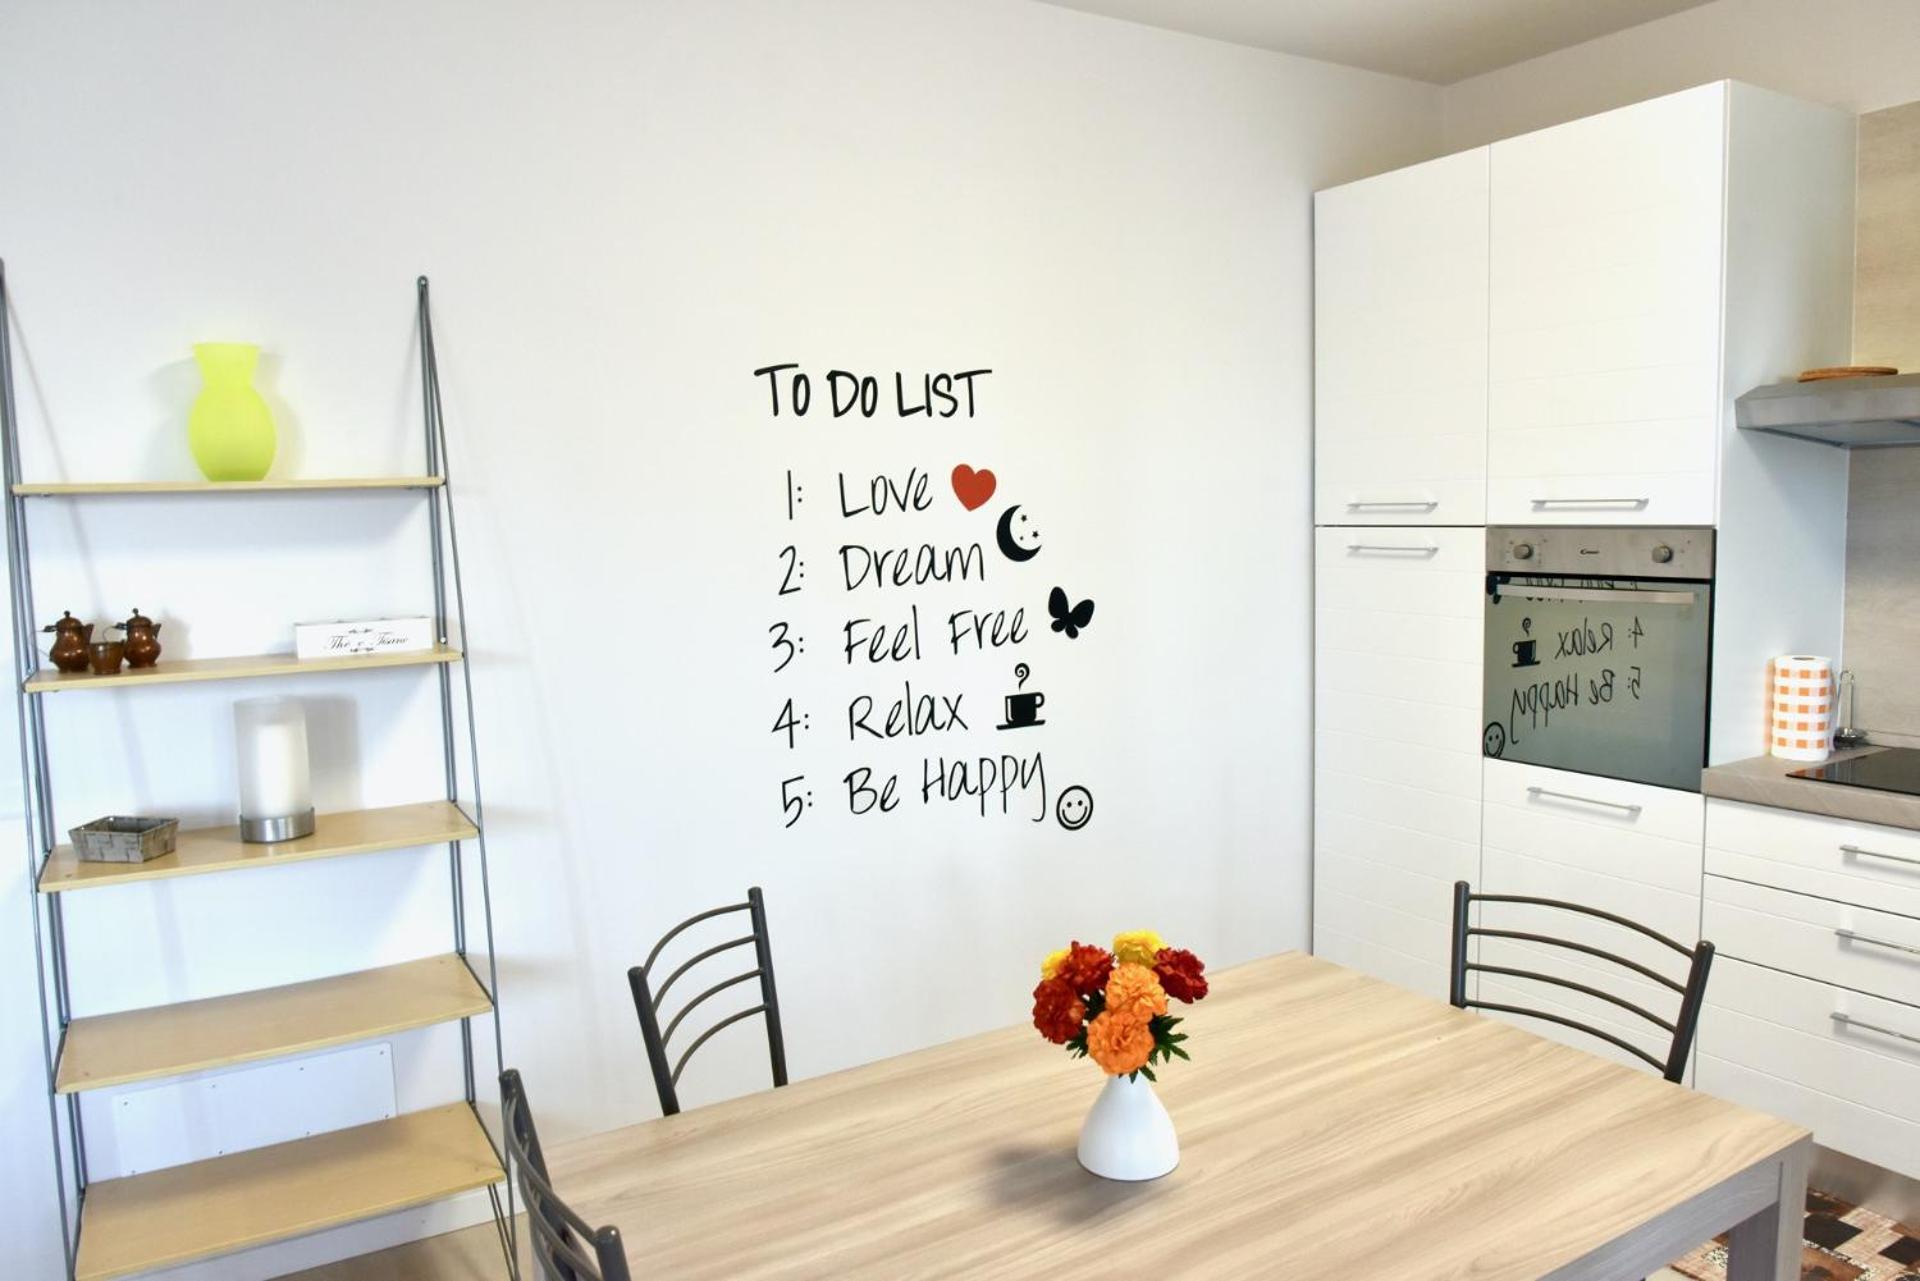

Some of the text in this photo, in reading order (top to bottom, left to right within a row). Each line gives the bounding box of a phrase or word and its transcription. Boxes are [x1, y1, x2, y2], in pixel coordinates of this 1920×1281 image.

[753, 363, 993, 418] TO DO LIST
[787, 467, 933, 521] 1: Love
[778, 543, 985, 596] 2: Dream
[768, 604, 1029, 673] 3: Feel Free
[771, 680, 969, 749] 4: Relax
[781, 752, 1046, 829] 5: Be Happy
